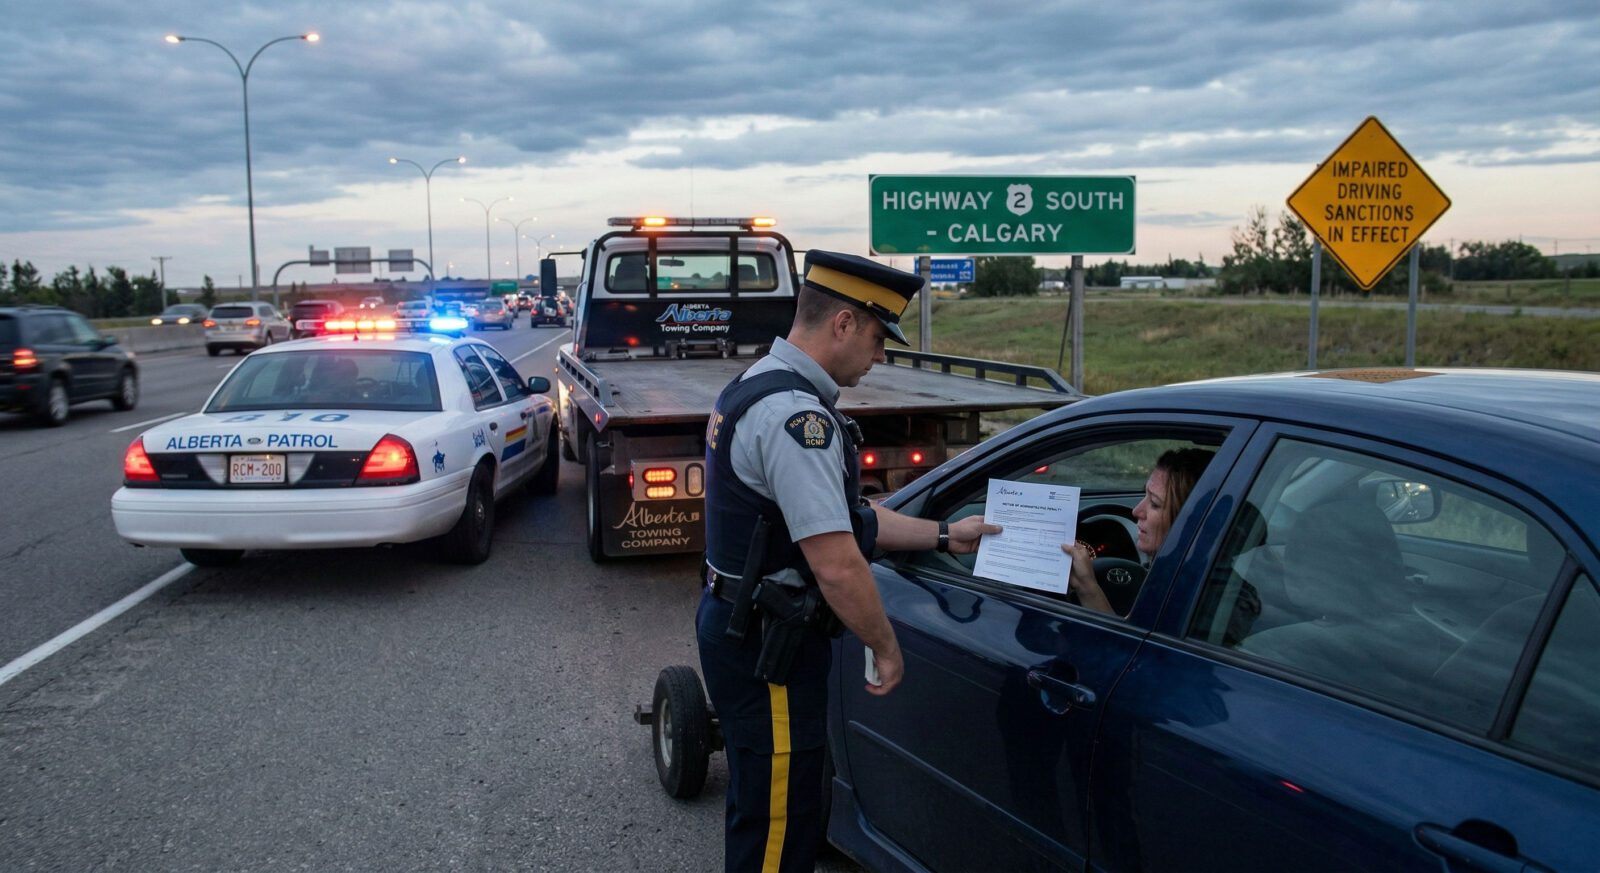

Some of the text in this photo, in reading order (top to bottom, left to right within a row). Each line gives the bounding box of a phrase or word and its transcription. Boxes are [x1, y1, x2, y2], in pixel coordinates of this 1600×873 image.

[1332, 161, 1408, 178] IMPAIRED
[1338, 183, 1402, 200] DRIVING
[882, 191, 1124, 210] HIGHWAY 2 SOUTH
[1324, 204, 1414, 221] SANCTIONS
[947, 223, 1063, 243] CALGARY
[1328, 226, 1409, 243] IN EFFECT
[660, 324, 730, 333] Towing Company
[166, 434, 338, 450] ALBERTA PATROL
[233, 463, 282, 476] RCM-200
[612, 501, 693, 529] Alberta
[629, 528, 681, 539] TOWING
[621, 537, 690, 548] COMPANY
